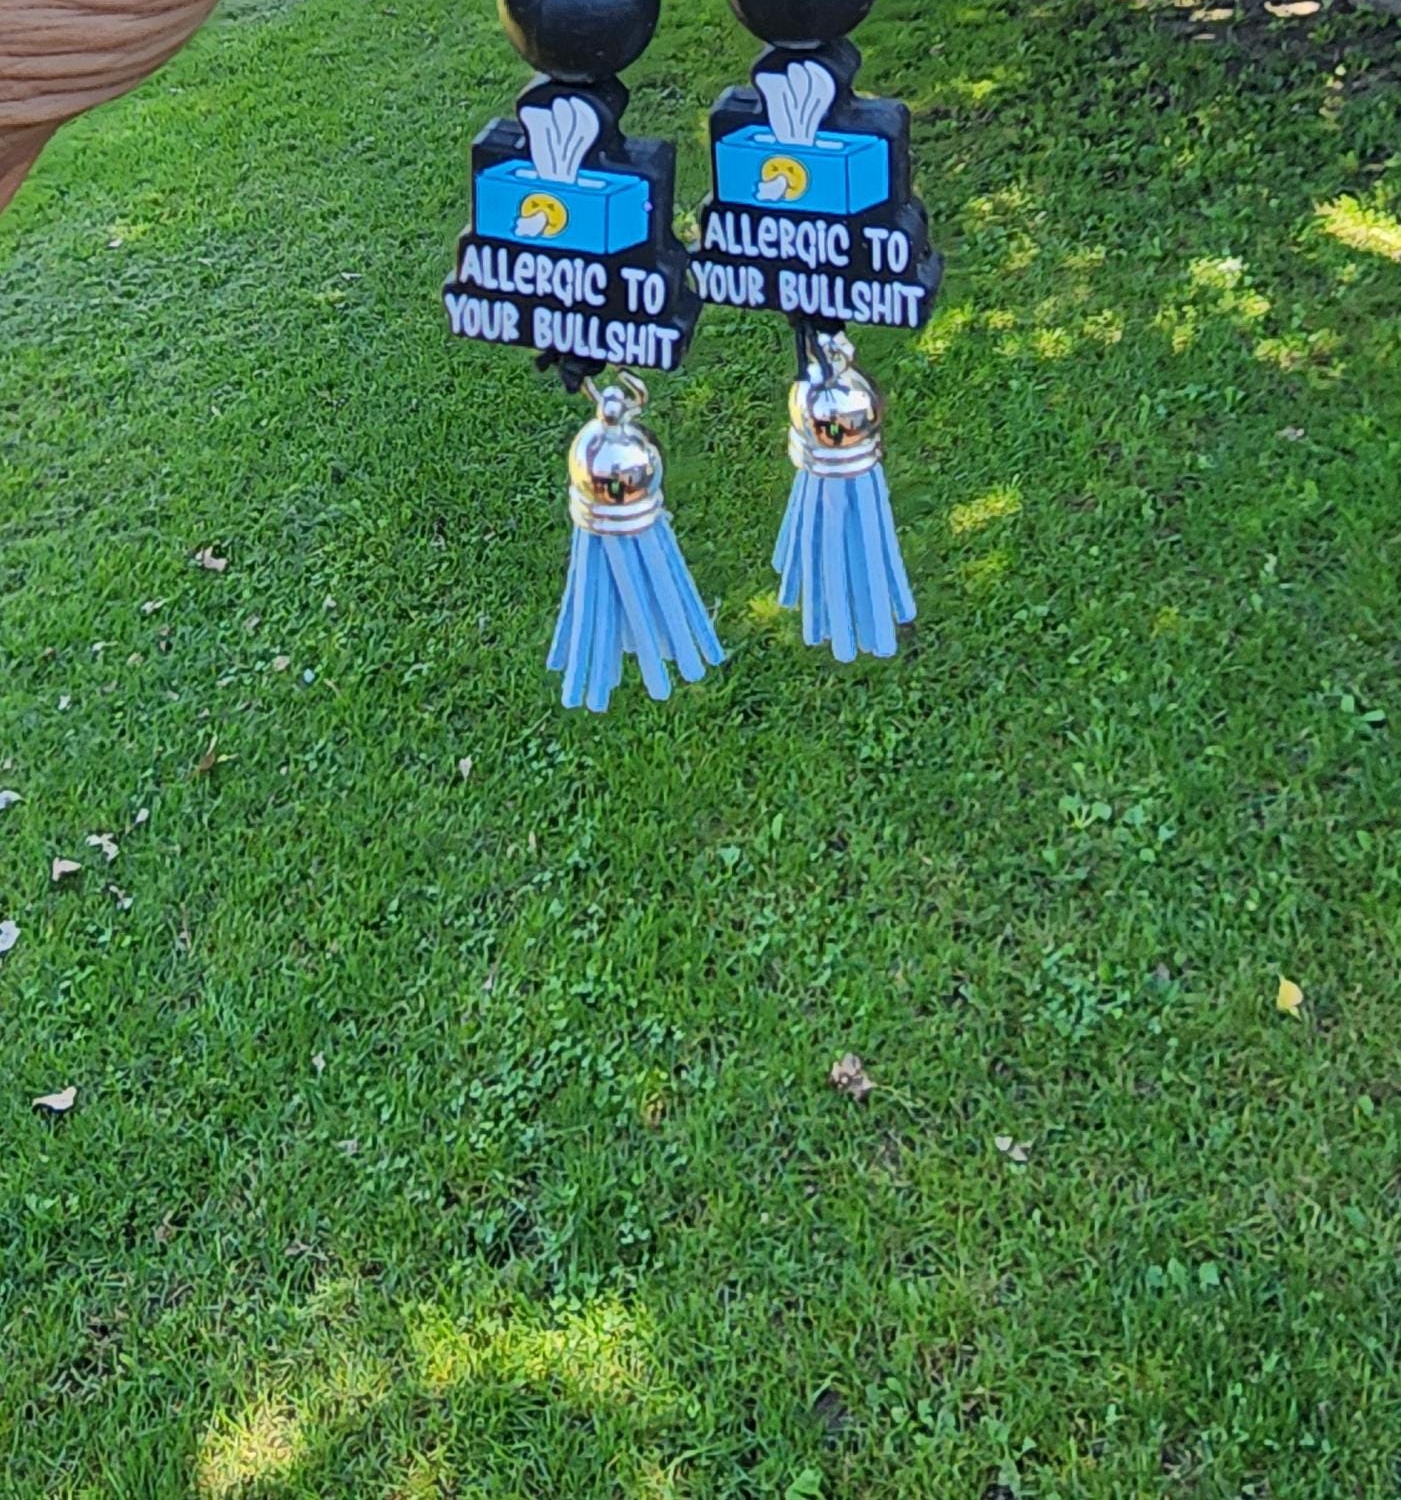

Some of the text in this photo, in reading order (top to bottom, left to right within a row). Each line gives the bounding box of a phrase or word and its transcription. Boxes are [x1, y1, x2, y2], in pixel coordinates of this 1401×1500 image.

[863, 226, 908, 274] TO
[621, 267, 667, 315] TO
[692, 261, 925, 327] YOUR BULLSHIT
[444, 293, 680, 370] YOUR BULLSHIT
